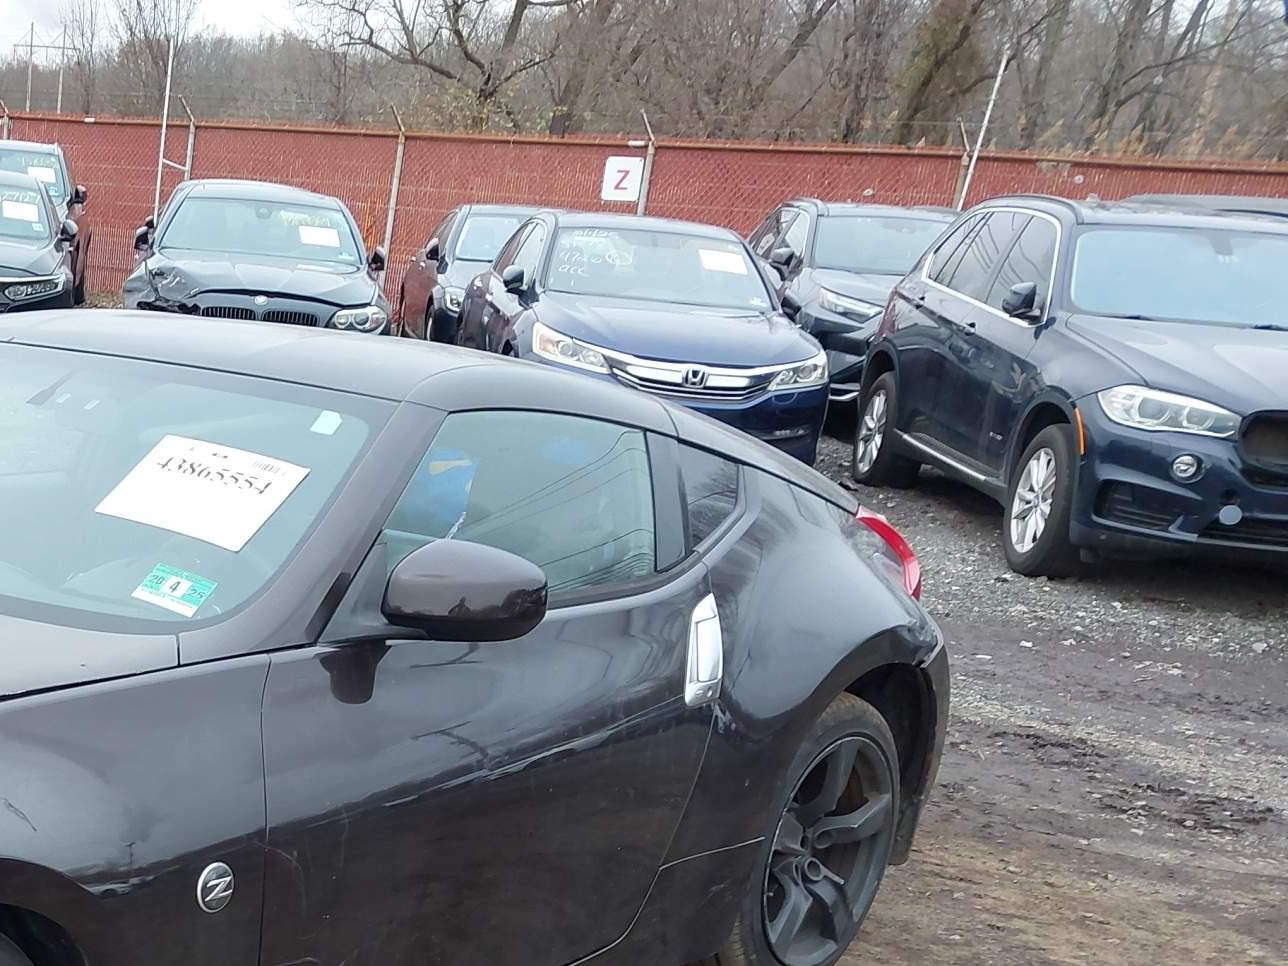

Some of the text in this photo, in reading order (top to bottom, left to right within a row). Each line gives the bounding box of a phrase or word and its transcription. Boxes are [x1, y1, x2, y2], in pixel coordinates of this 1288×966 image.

[614, 169, 630, 190] Z
[157, 456, 272, 494] 43865554
[151, 574, 165, 585] 20
[169, 581, 182, 593] 4
